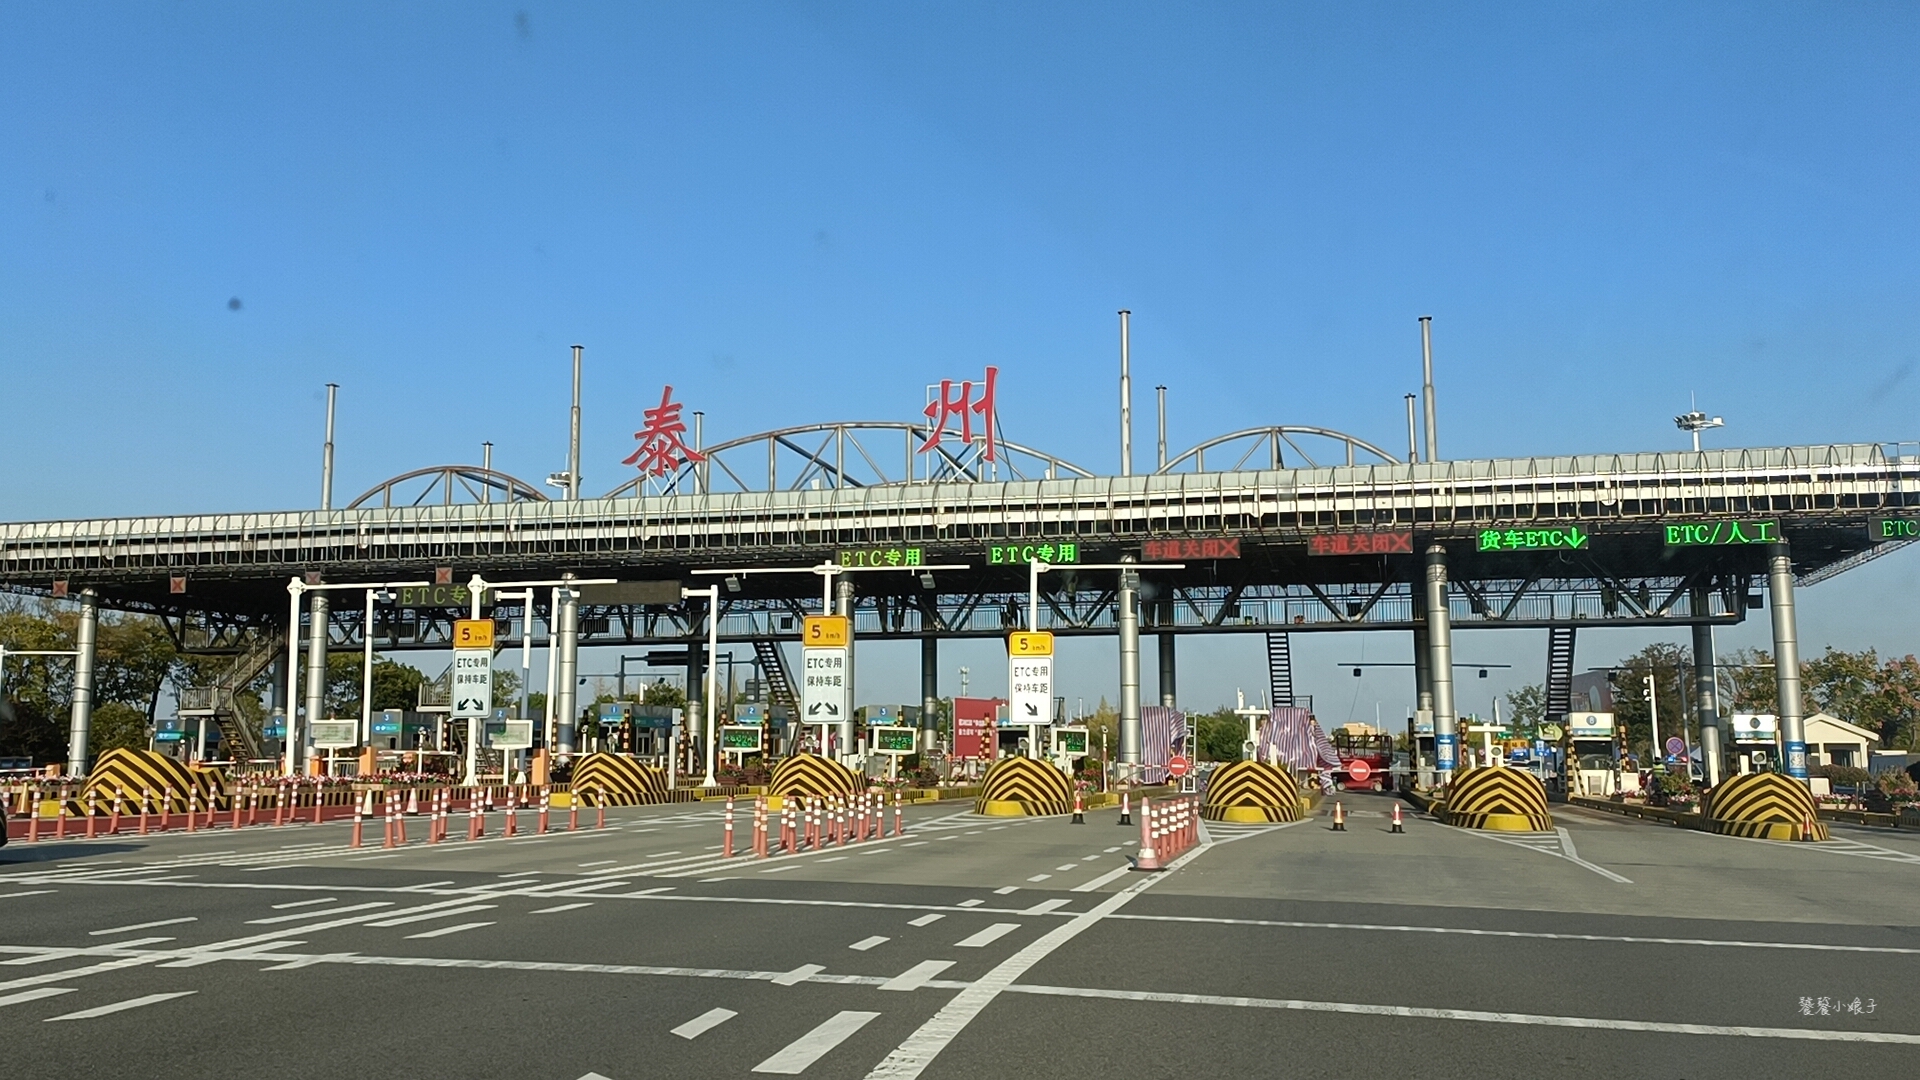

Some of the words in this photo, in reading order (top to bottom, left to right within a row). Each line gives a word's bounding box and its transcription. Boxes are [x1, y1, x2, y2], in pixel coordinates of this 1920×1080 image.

[621, 366, 999, 477] 泰州
[1666, 522, 1777, 544] ETC/人工
[1882, 520, 1920, 537] ETC
[1312, 534, 1390, 554] 车道关闭
[1480, 529, 1563, 550] 货车ETC
[841, 548, 921, 567] ETC专用
[991, 543, 1077, 563] ETC专用
[1145, 539, 1217, 559] 车道关闭
[402, 585, 488, 605] ETC专
[462, 628, 471, 641] 5
[812, 624, 821, 639] 5
[1020, 638, 1029, 651] 5
[457, 657, 488, 668] ETC专用
[807, 657, 842, 669] ETC专用
[1014, 665, 1048, 677] ETC专用
[457, 673, 488, 685] 保持车距
[807, 675, 842, 687] 保持车距
